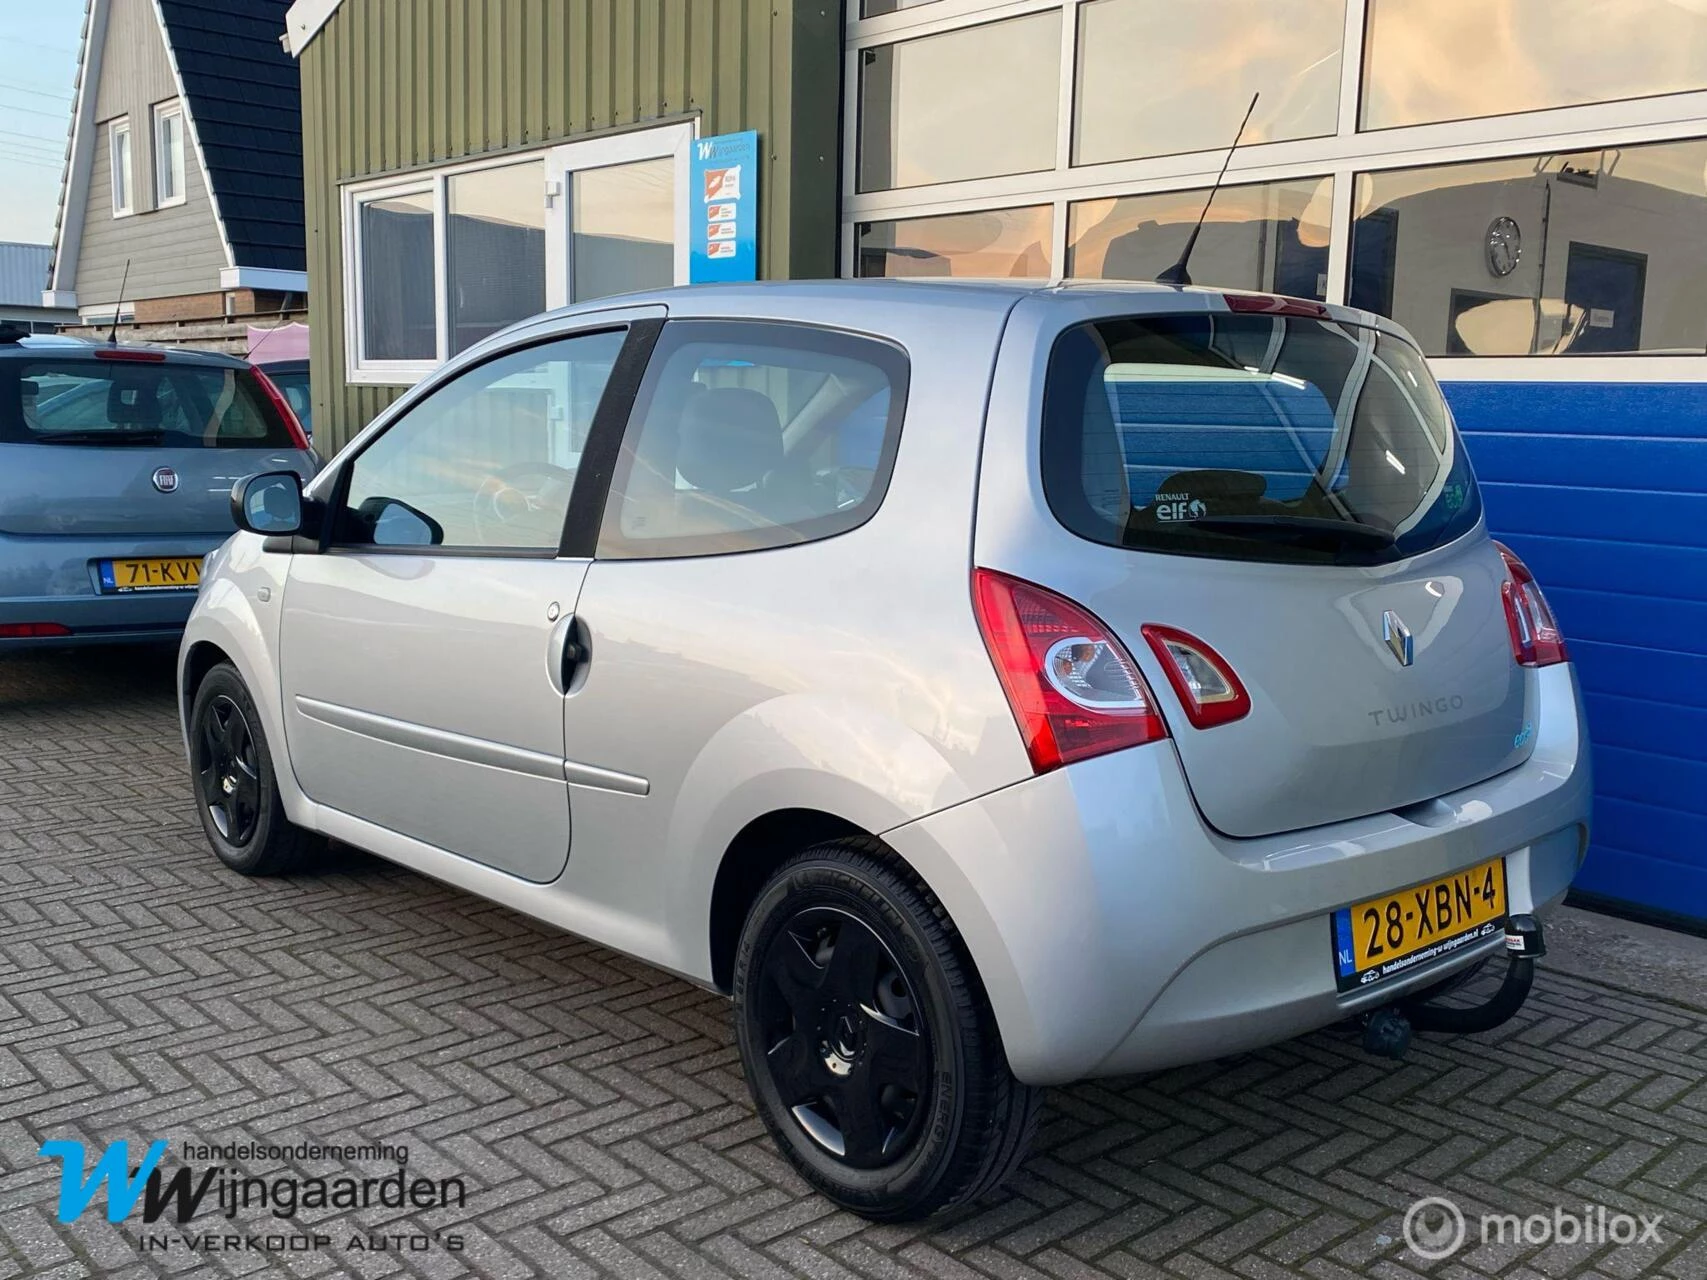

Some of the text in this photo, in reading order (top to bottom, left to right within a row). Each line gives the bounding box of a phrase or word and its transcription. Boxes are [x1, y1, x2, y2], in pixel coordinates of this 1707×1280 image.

[159, 474, 174, 486] FIAT
[1155, 493, 1189, 502] RENAULT
[1156, 502, 1187, 520] elf
[1368, 695, 1464, 727] TWINGO
[1363, 866, 1496, 959] 28-XBN-4
[1338, 950, 1353, 966] NL
